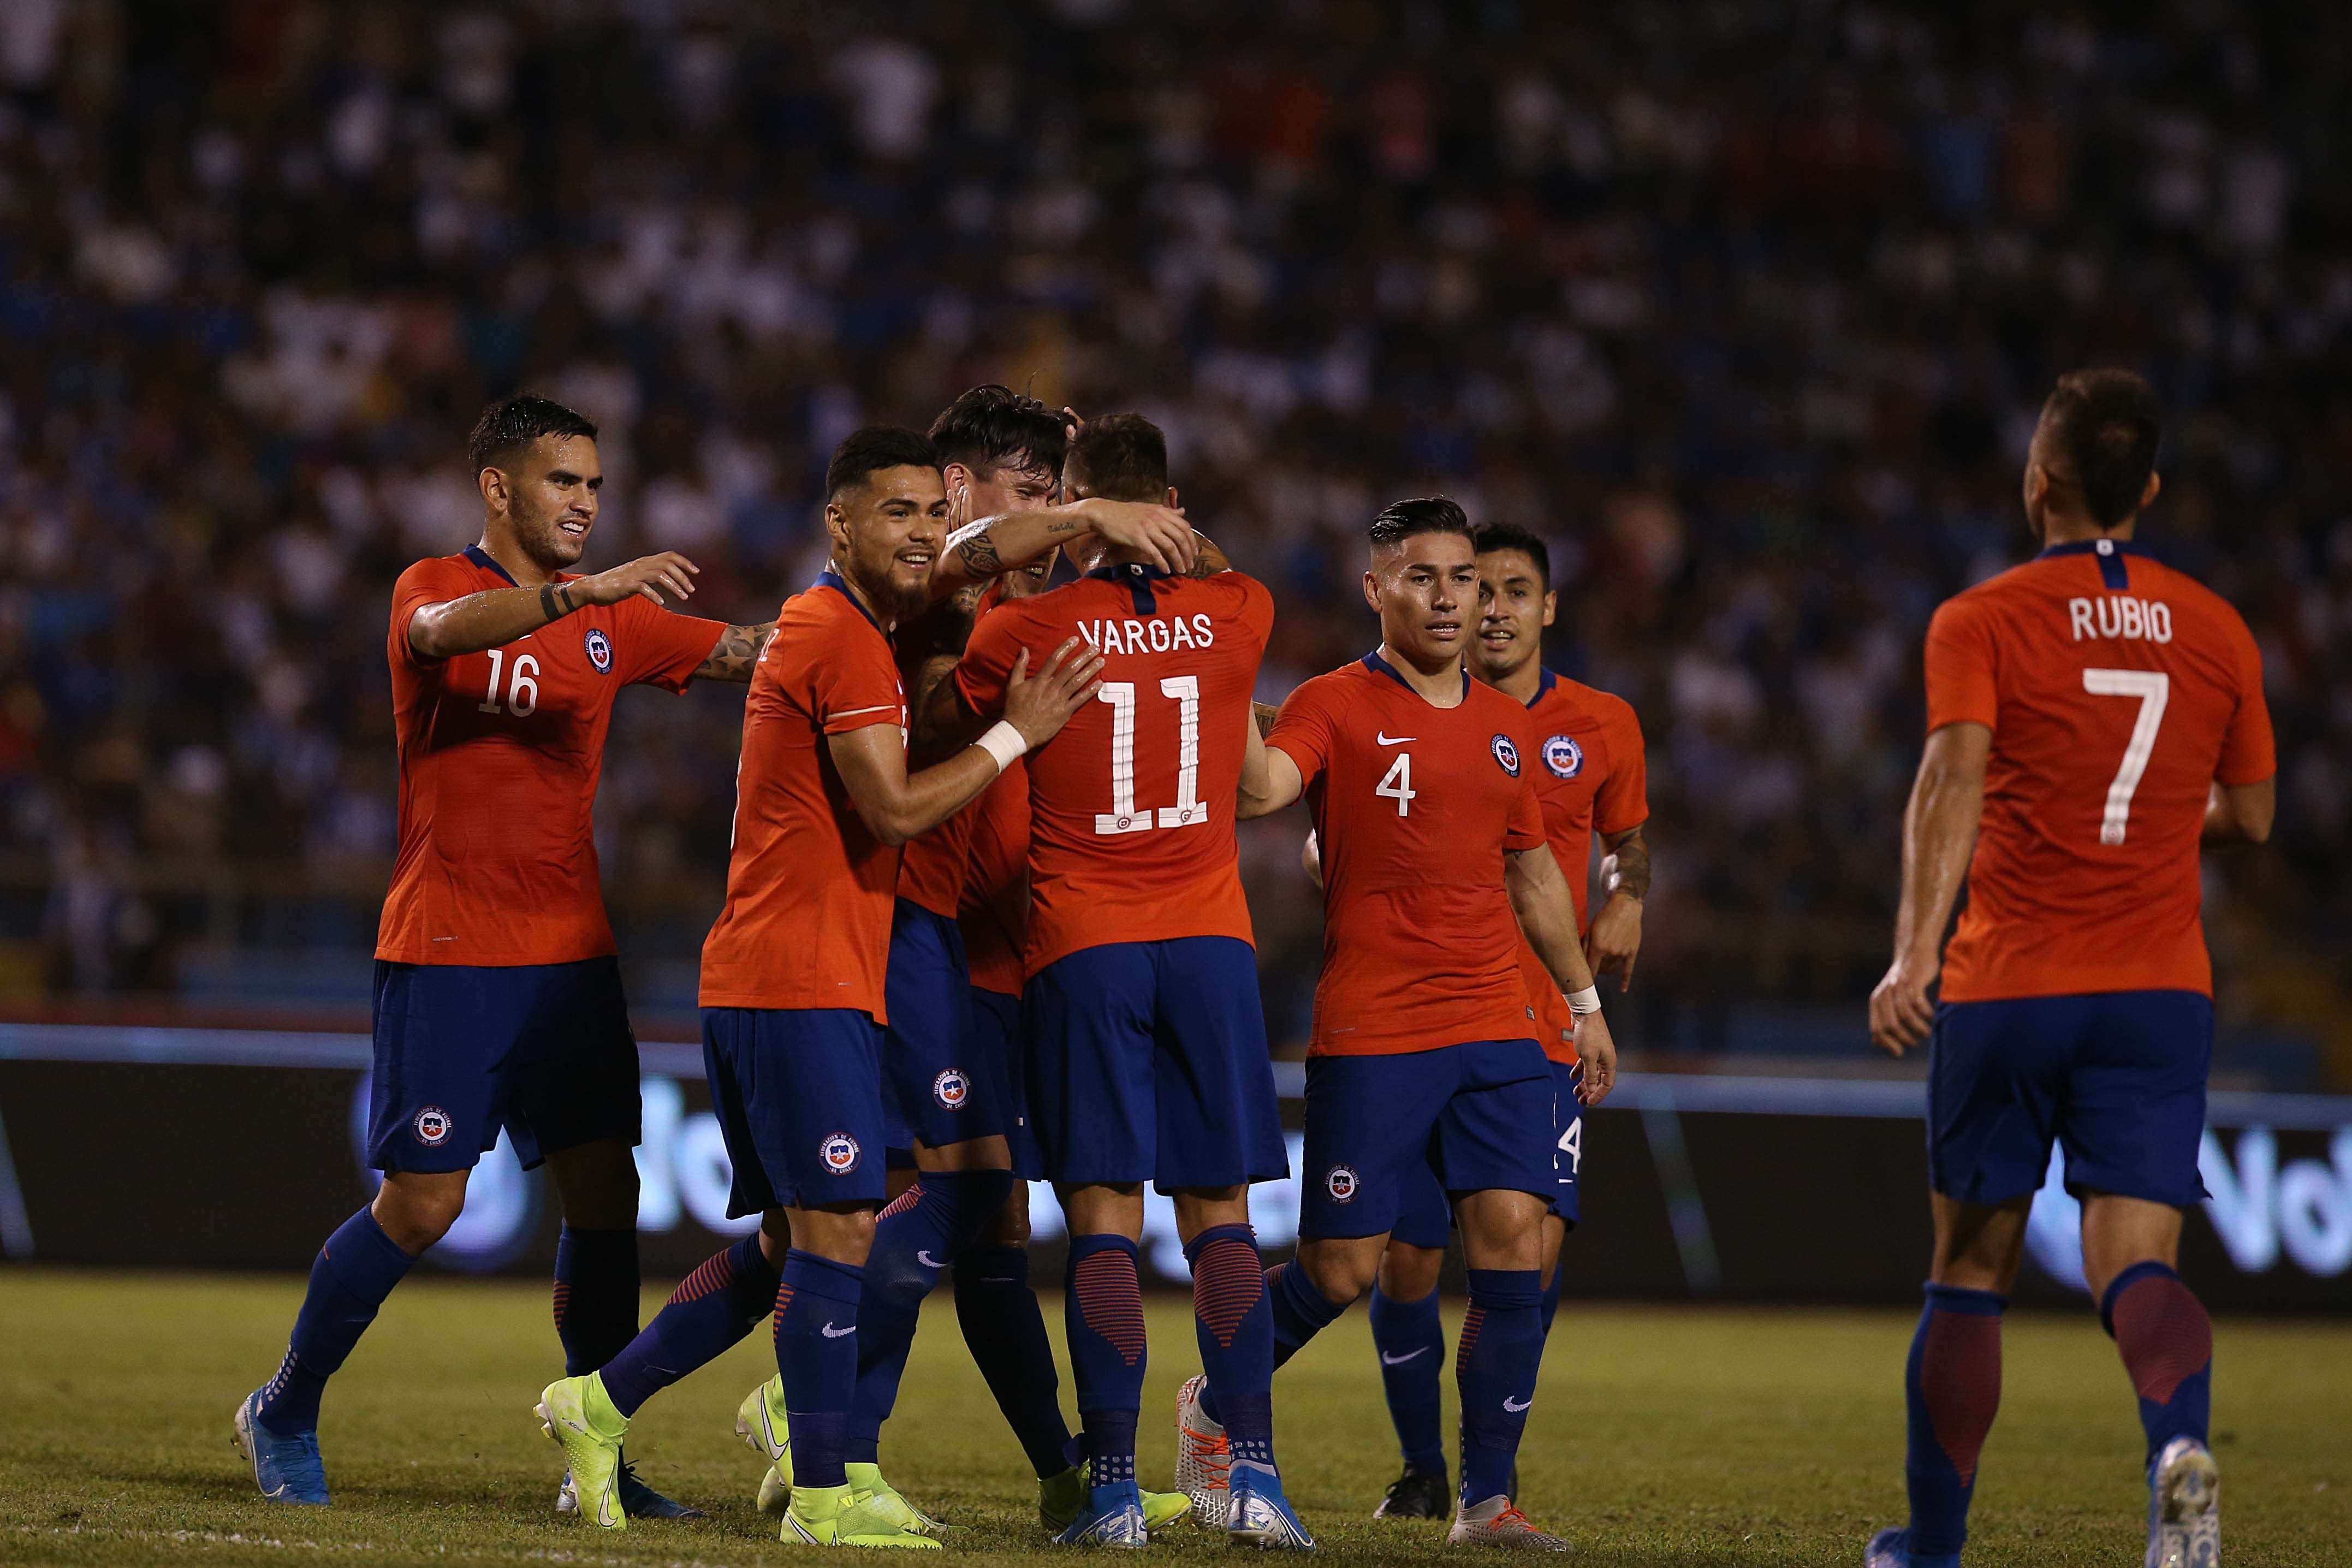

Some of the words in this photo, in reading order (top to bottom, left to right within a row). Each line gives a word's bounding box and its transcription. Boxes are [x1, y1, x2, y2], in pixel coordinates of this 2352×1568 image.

[1077, 613, 1214, 655] VARGAS
[2069, 596, 2172, 643] RUBIO
[478, 648, 540, 718] 16
[1095, 675, 1209, 835] 11
[1375, 752, 1417, 817] 4
[2082, 668, 2170, 845] 7
[1557, 1116, 1582, 1174] 4
